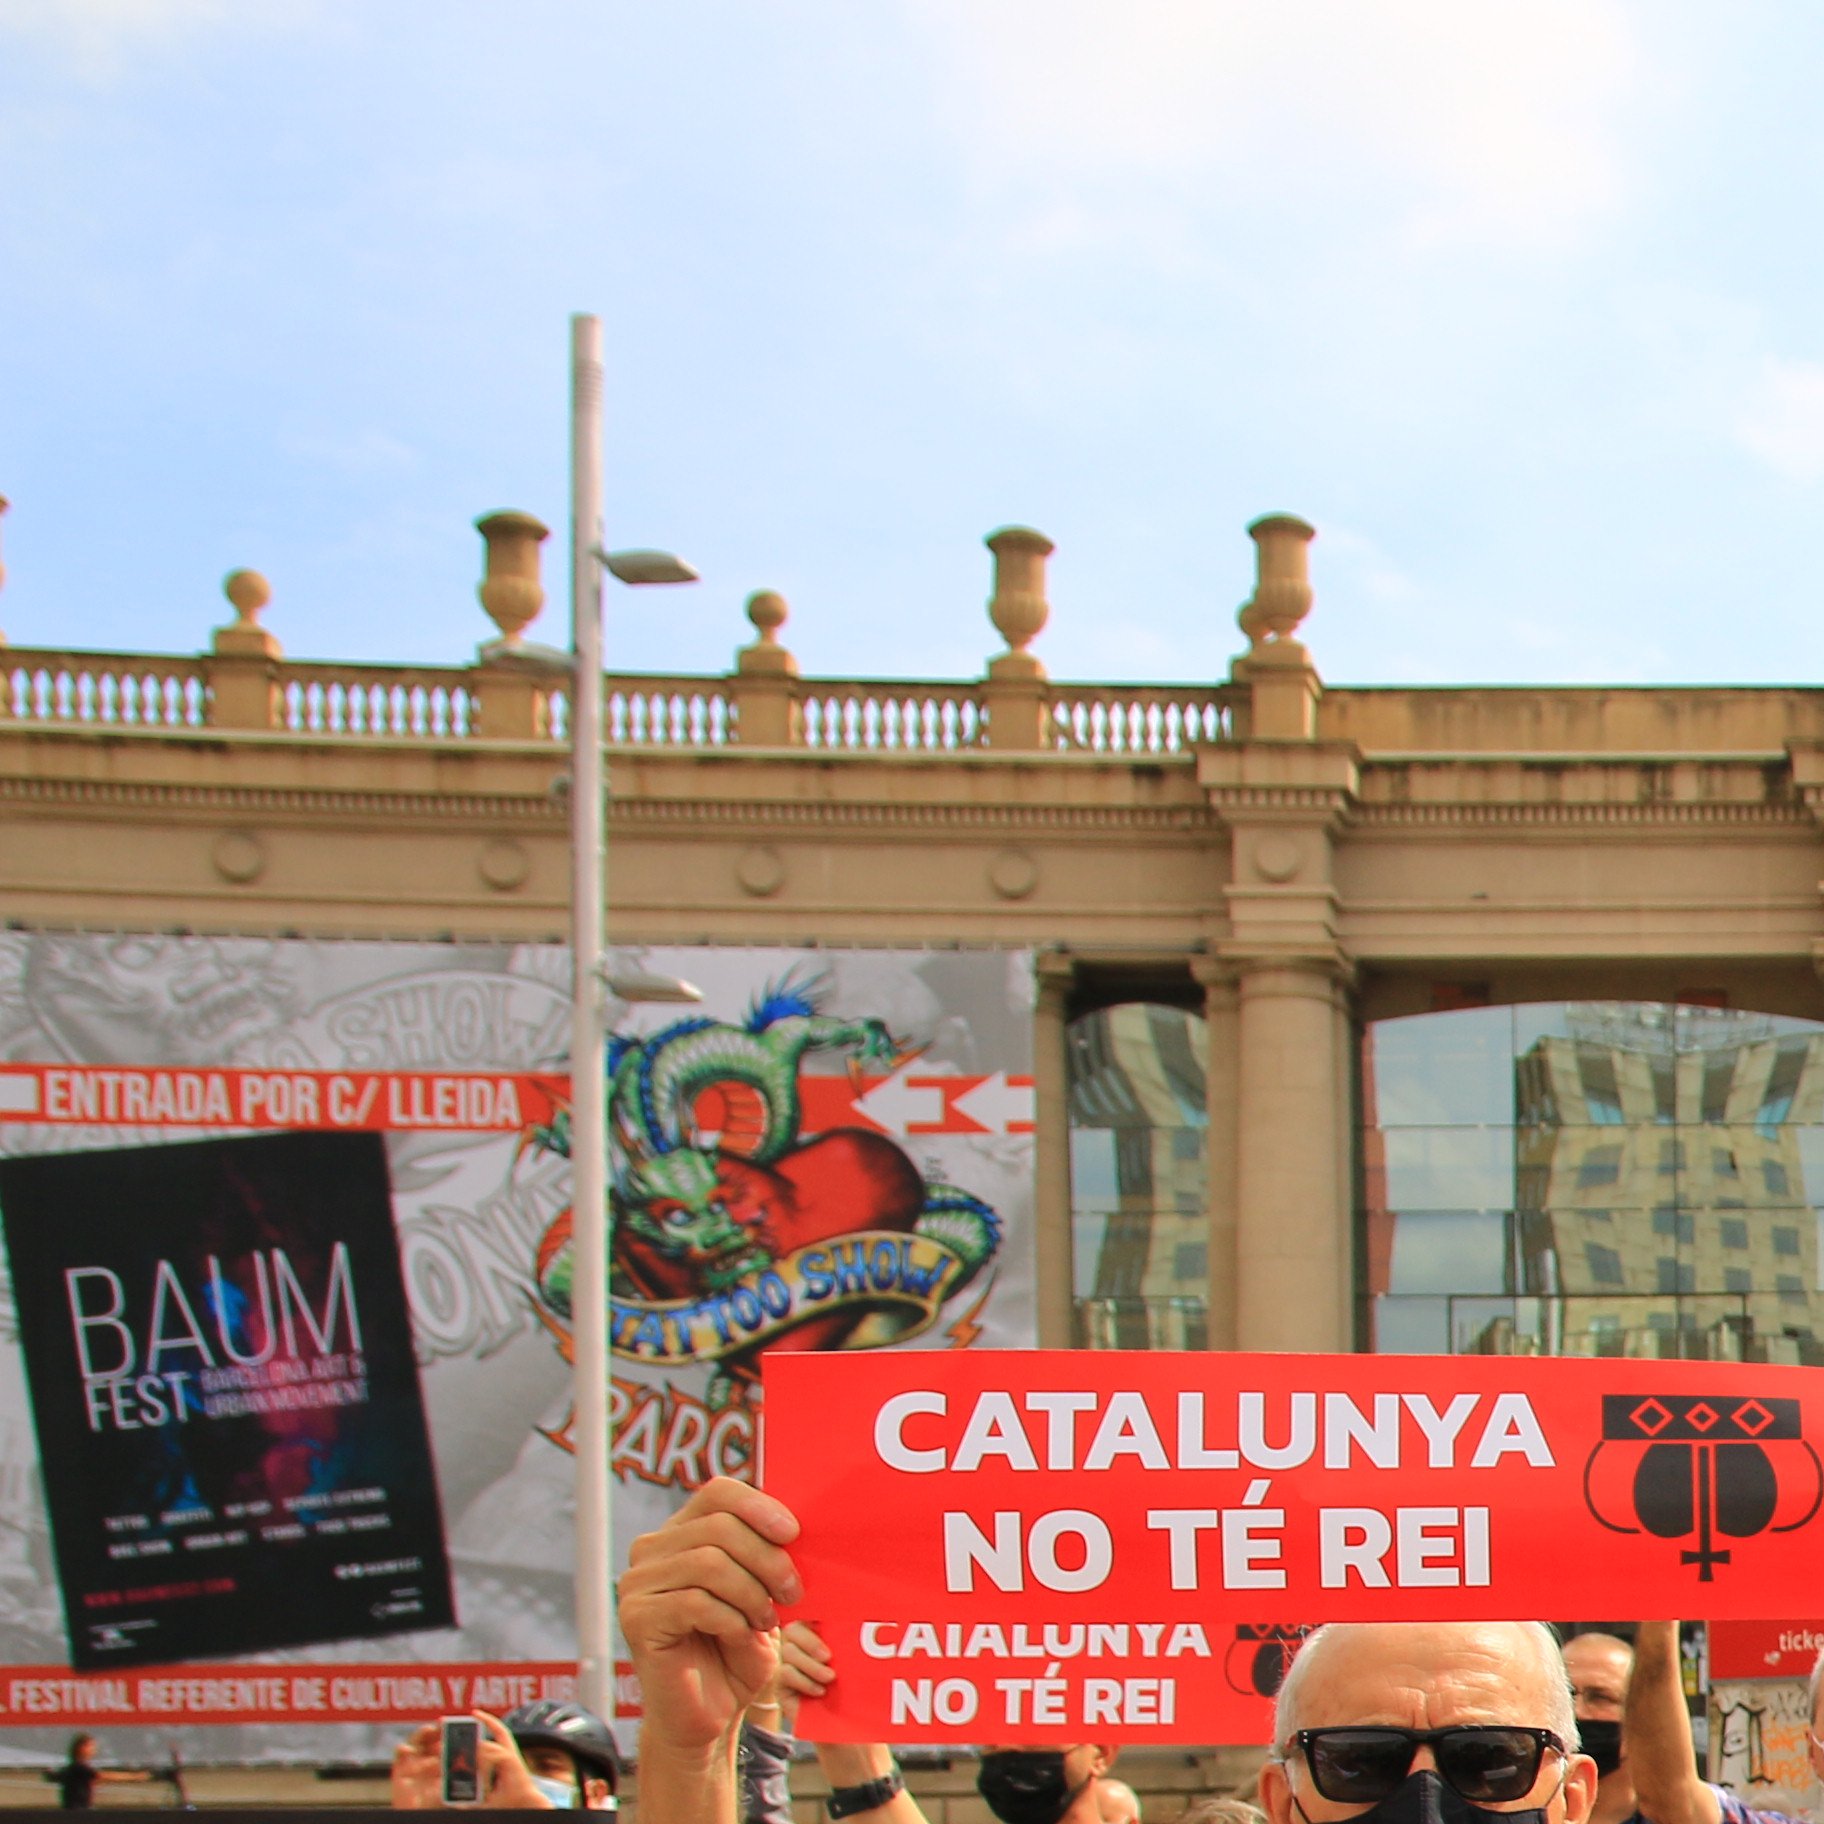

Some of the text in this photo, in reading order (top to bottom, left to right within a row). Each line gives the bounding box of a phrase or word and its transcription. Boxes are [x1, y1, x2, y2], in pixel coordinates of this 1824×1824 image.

[44, 1070, 521, 1127] ENTRADA POR C/ LLEIDA
[64, 1240, 364, 1380] BAUM
[610, 1240, 956, 1356] TATTOO SHOW
[84, 1370, 191, 1433] FEST
[566, 1385, 754, 1483] ARC
[874, 1390, 1556, 1473] CATALUNYA
[943, 1479, 1493, 1594] NO TÉ REI
[859, 1621, 1212, 1658] CATALUNYA
[10, 1679, 128, 1713] FESTIVAL
[139, 1677, 286, 1712] REFERENTE
[292, 1677, 325, 1711] DE
[330, 1675, 445, 1711] CULTURA
[448, 1675, 464, 1709] Y
[471, 1673, 538, 1709] ARTE
[890, 1663, 1177, 1726] NO TÉ REI
